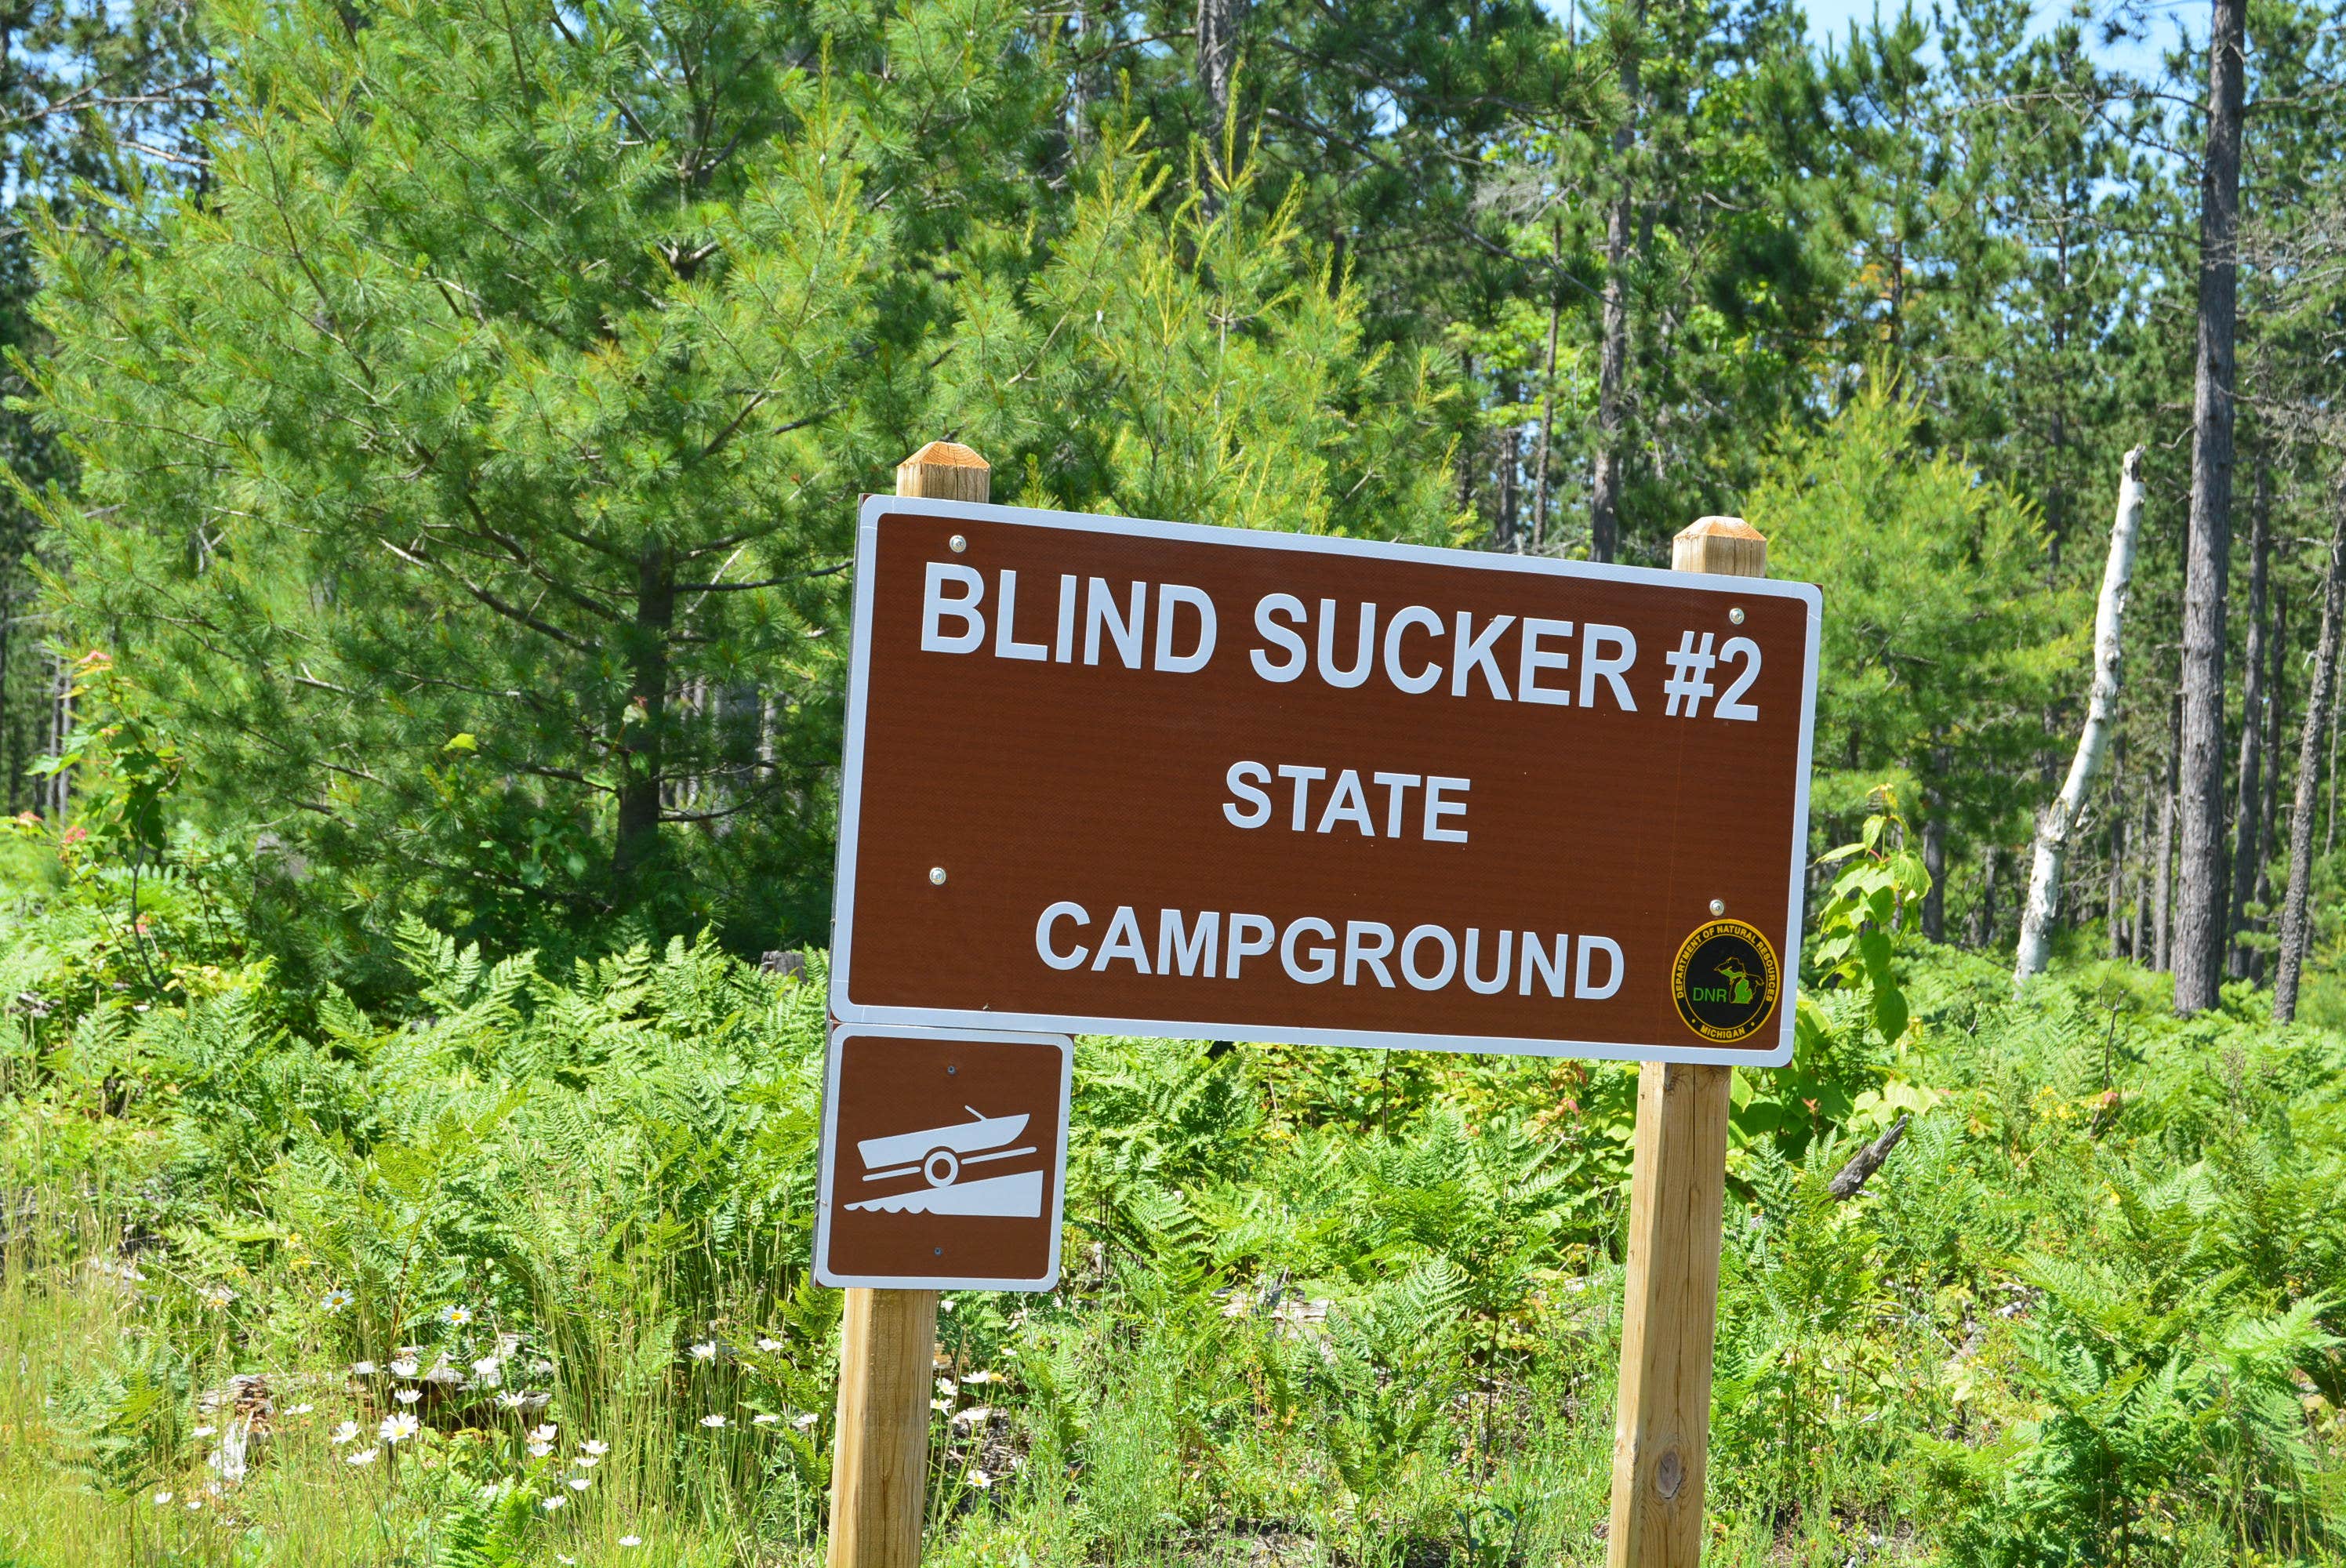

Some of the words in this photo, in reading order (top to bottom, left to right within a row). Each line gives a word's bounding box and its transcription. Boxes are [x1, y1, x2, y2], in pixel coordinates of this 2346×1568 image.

[921, 561, 1218, 673] BLIND
[1249, 593, 1638, 712] SUCKER
[1664, 630, 1762, 722] #2
[1222, 760, 1471, 844] STATE
[1035, 901, 1625, 1000] CAMPGROUND
[1674, 936, 1702, 999] DEPARTMENT
[1703, 927, 1715, 938] OF
[1716, 925, 1756, 943] NATURAL
[1756, 941, 1776, 1002] RESOURCES
[1693, 987, 1727, 1003] DNR
[1700, 1025, 1745, 1039] MICHIGAN
